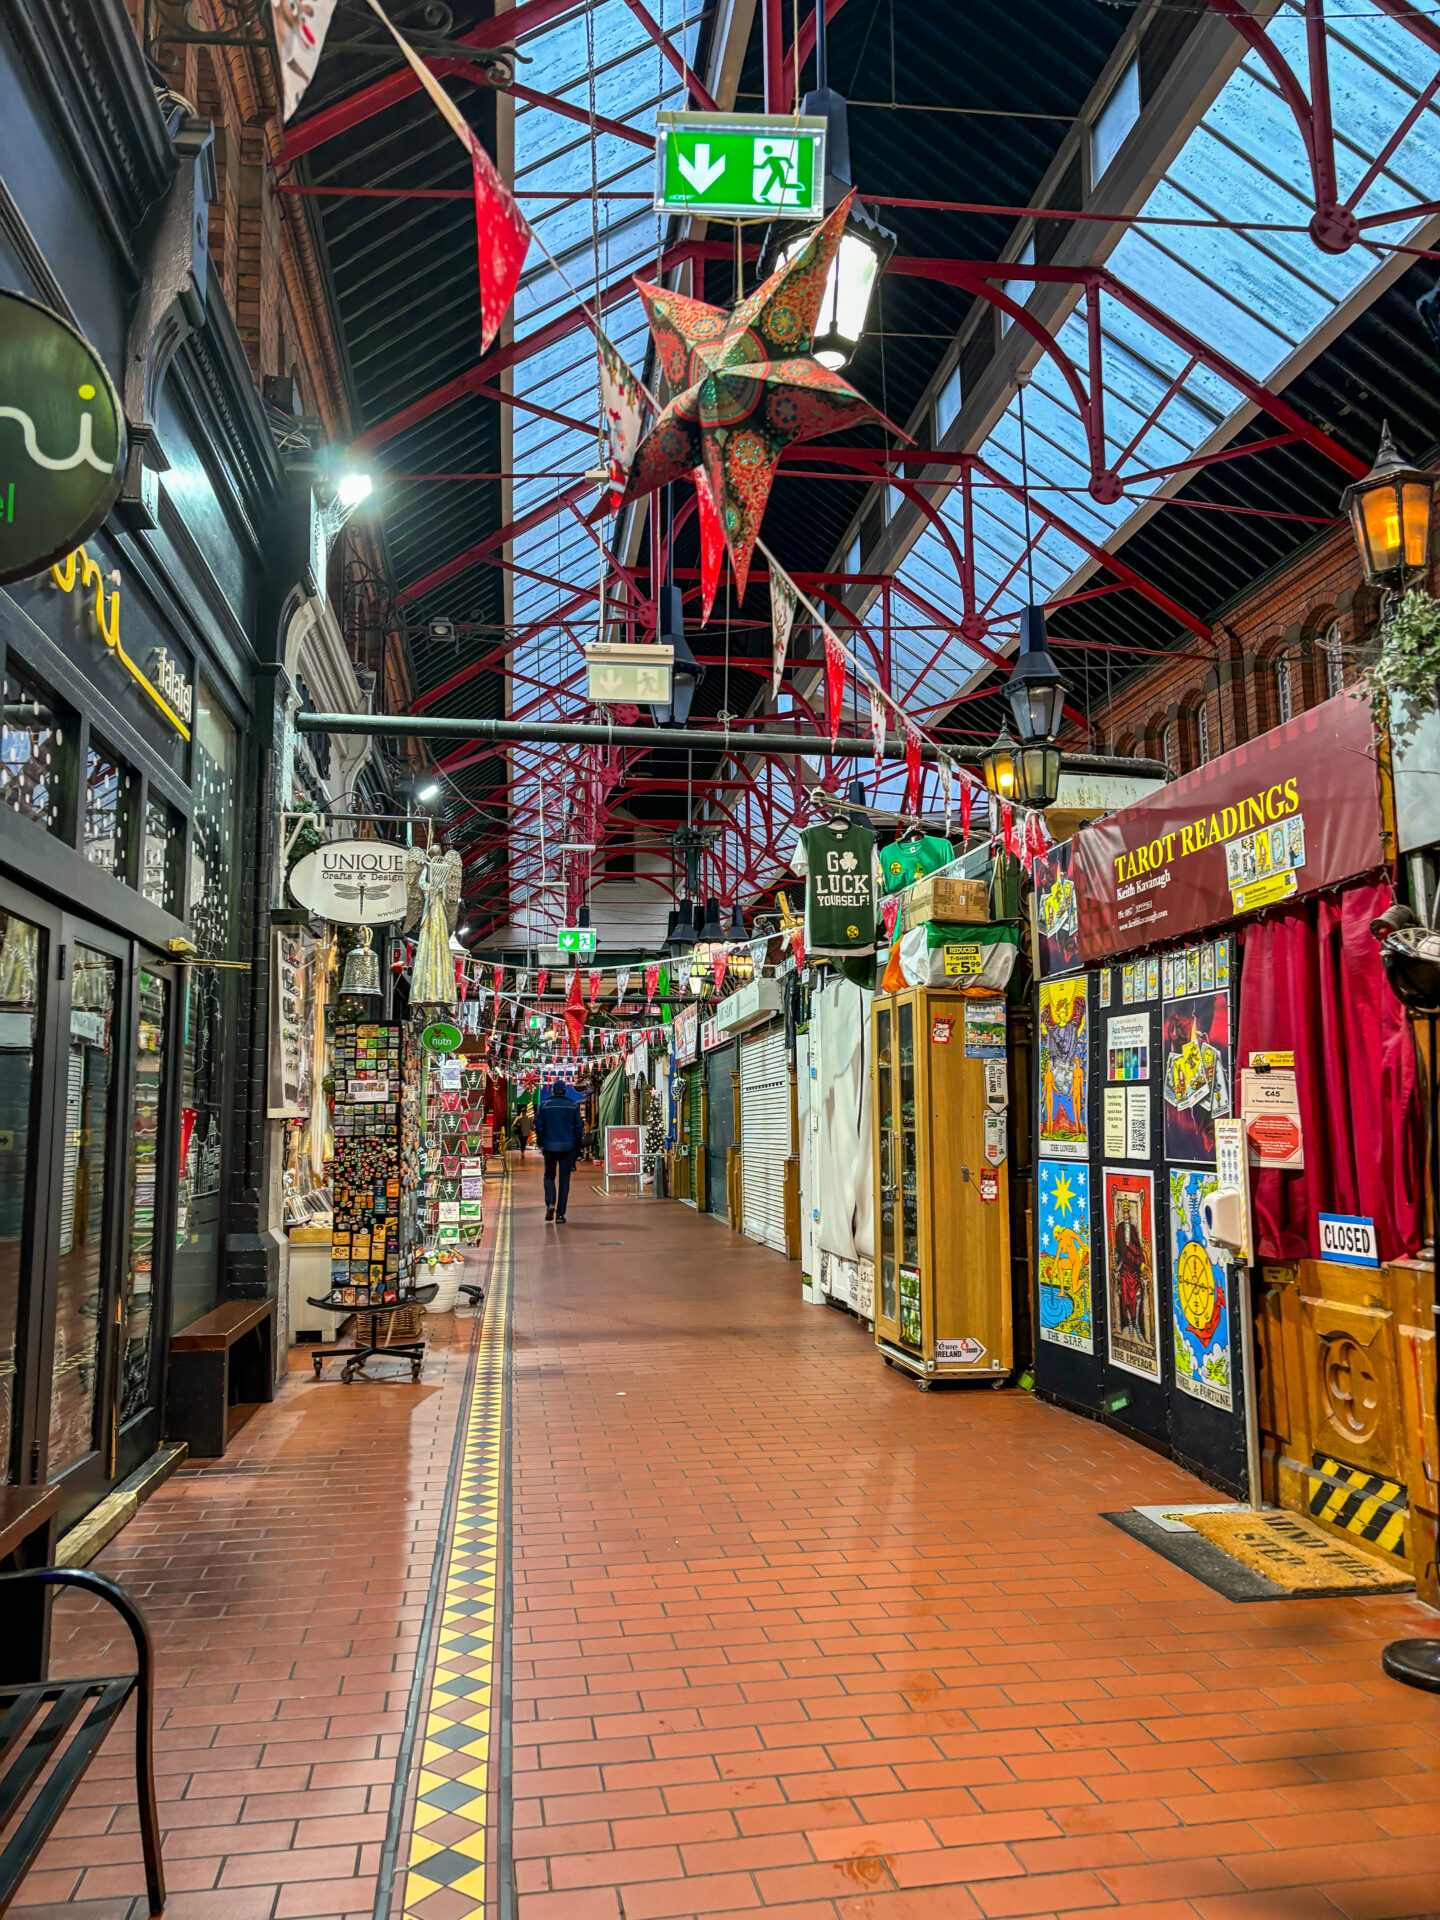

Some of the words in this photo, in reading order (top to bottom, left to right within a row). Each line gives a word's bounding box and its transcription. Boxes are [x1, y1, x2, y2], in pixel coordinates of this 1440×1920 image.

[1114, 832, 1176, 884] TAROT
[1180, 776, 1299, 857] READINGS
[323, 853, 403, 872] UNIQUE
[322, 872, 352, 880] Crafts
[357, 872, 366, 880] &
[371, 873, 404, 882] Design
[815, 874, 870, 894] LUCK
[1116, 881, 1136, 901] Keith
[1136, 869, 1172, 894] Kavanagh
[817, 894, 870, 907] YOURSELF!
[967, 1005, 1004, 1013] IRELAND
[431, 1037, 452, 1046] nutri
[1264, 1090, 1281, 1098] €45
[1324, 1223, 1370, 1254] CLOSED
[1047, 1330, 1061, 1343] THE
[935, 1350, 962, 1358] IRELAND
[1113, 1350, 1125, 1361] THE
[1199, 1384, 1232, 1408] FORTUNE
[1233, 1533, 1307, 1566] STEP
[1262, 1515, 1329, 1548] MIND
[1320, 1550, 1384, 1578] THE
